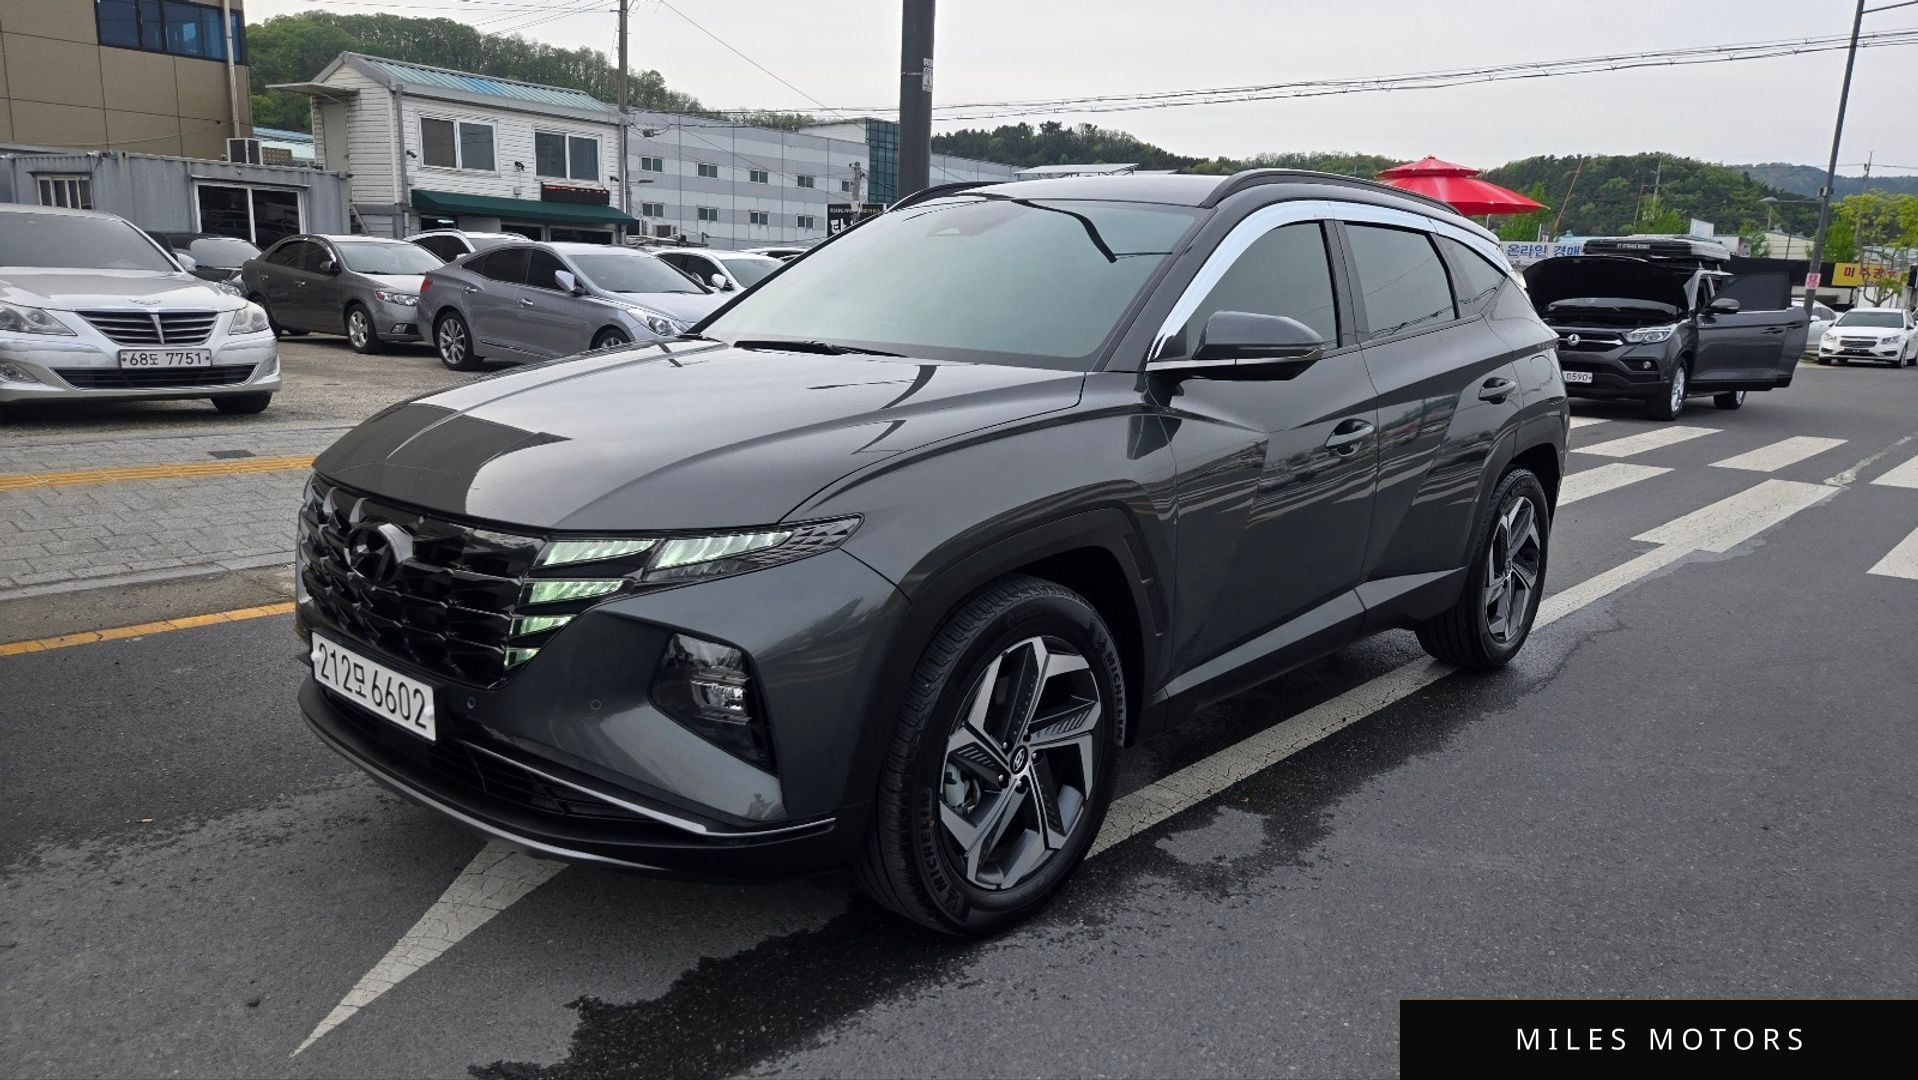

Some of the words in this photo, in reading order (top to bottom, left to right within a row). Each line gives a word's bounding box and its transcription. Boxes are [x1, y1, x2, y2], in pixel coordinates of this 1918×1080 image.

[1507, 244, 1547, 258] 온라인
[129, 352, 159, 366] 68도
[165, 352, 202, 366] 7751
[318, 642, 427, 730] 212모6602
[1105, 650, 1125, 741] MICHELIN
[920, 792, 949, 893] MICHELIN
